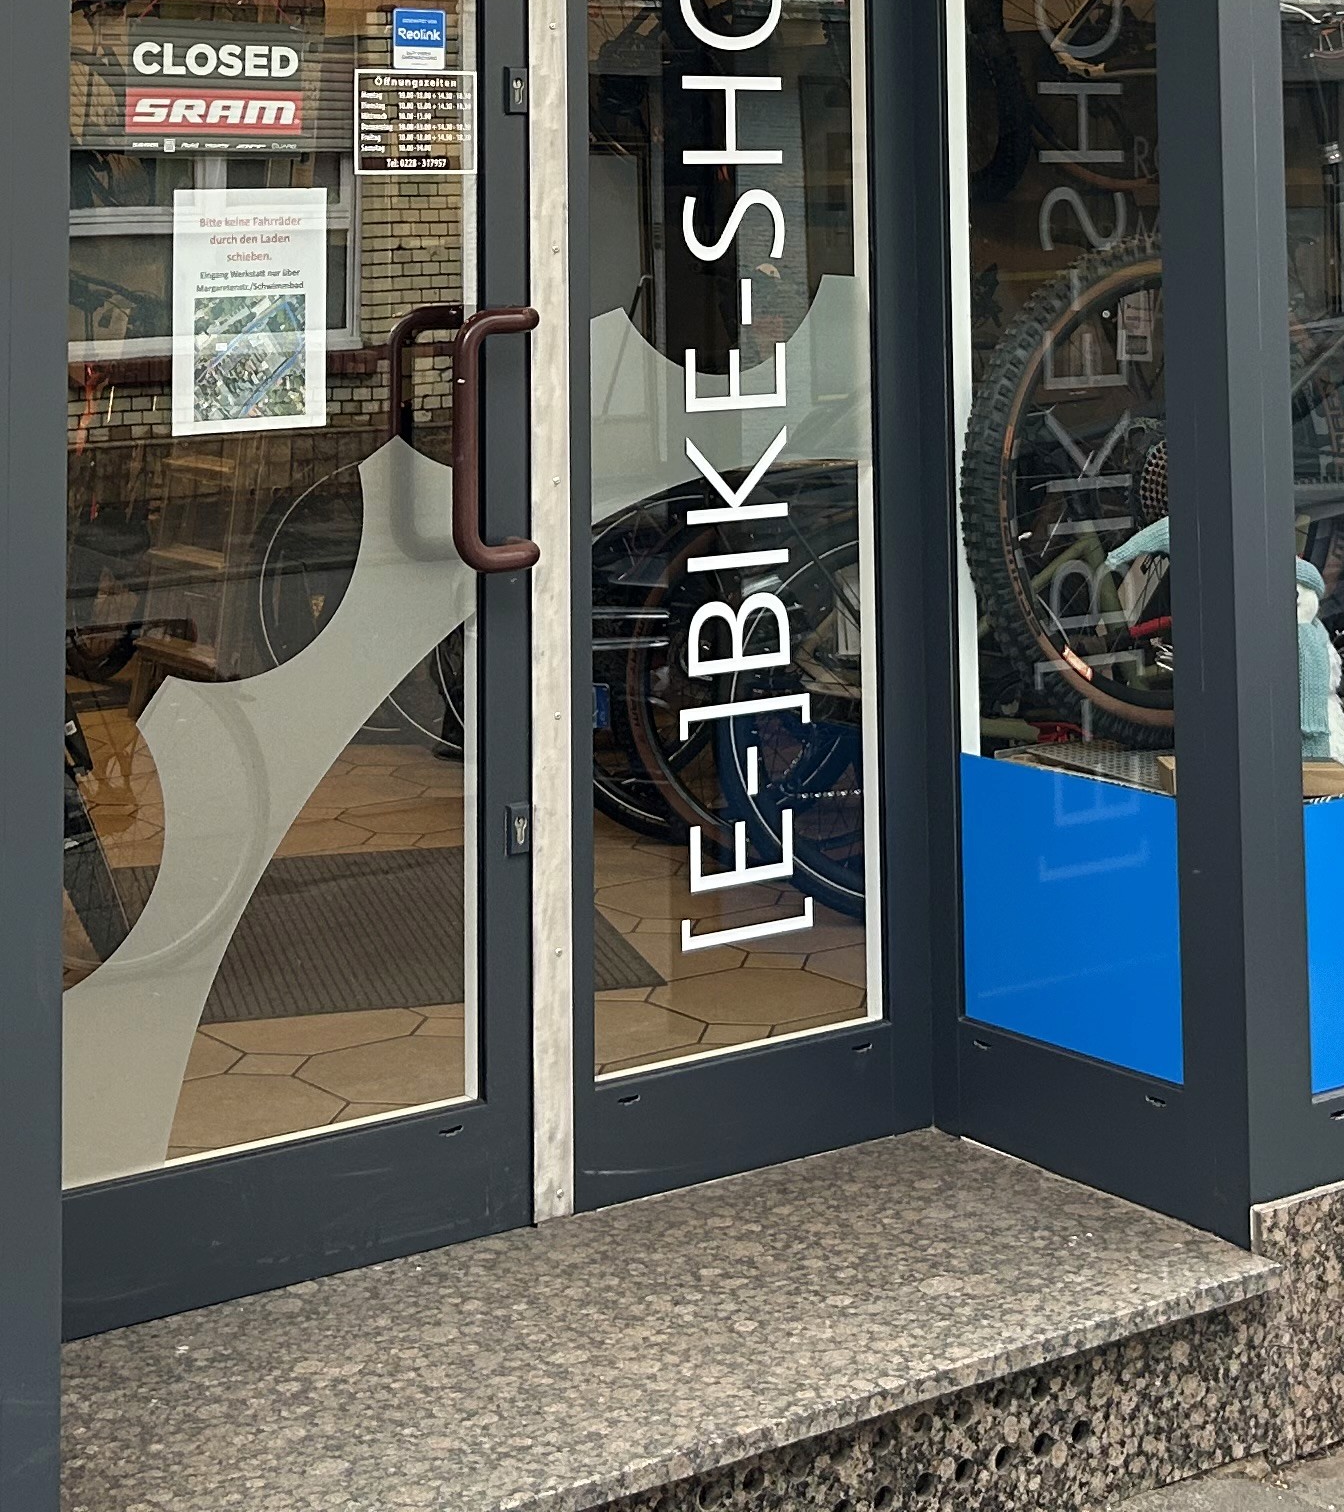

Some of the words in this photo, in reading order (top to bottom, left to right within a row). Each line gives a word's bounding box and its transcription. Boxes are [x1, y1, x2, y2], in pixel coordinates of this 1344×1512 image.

[397, 26, 442, 42] Reolink
[132, 41, 299, 78] CLOSED
[374, 75, 457, 90] Öffnungszeiten
[132, 98, 296, 125] SRAM
[199, 217, 222, 228] Bitte
[225, 216, 250, 227] keine
[252, 216, 302, 227] Fahrräder
[209, 234, 238, 245] durch
[239, 234, 258, 244] den
[260, 233, 291, 244] Laden
[226, 251, 272, 262] schieben.
[230, 269, 266, 278] Werkstatt
